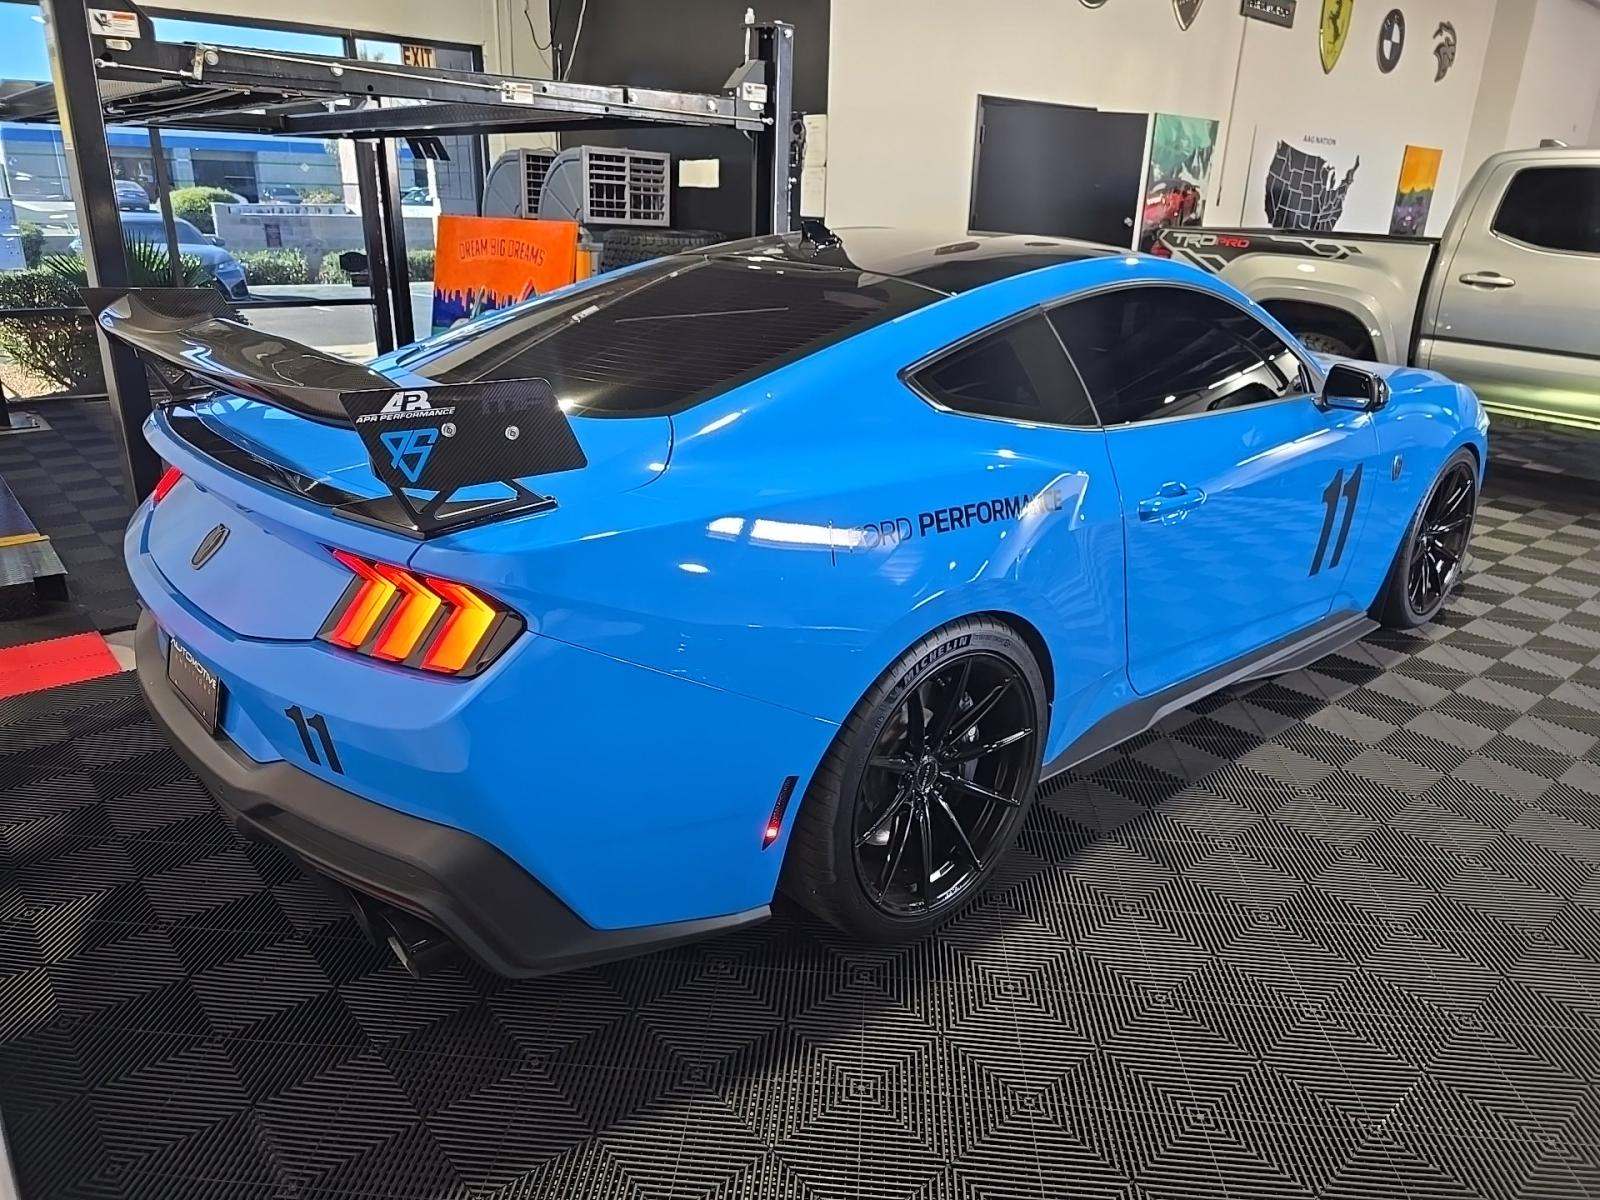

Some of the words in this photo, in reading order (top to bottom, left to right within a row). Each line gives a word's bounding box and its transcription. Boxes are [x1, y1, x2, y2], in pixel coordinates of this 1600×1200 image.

[402, 46, 432, 68] EXIT
[460, 239, 488, 260] DREAM
[490, 238, 506, 257] BIG
[508, 240, 546, 266] DREAMS
[356, 415, 378, 423] APR
[379, 408, 456, 421] PERFORMANCE
[1308, 463, 1364, 577] 11
[170, 638, 217, 690] AUTOMOTIVE
[902, 634, 970, 683] MICHELIN
[284, 704, 345, 776] 11
